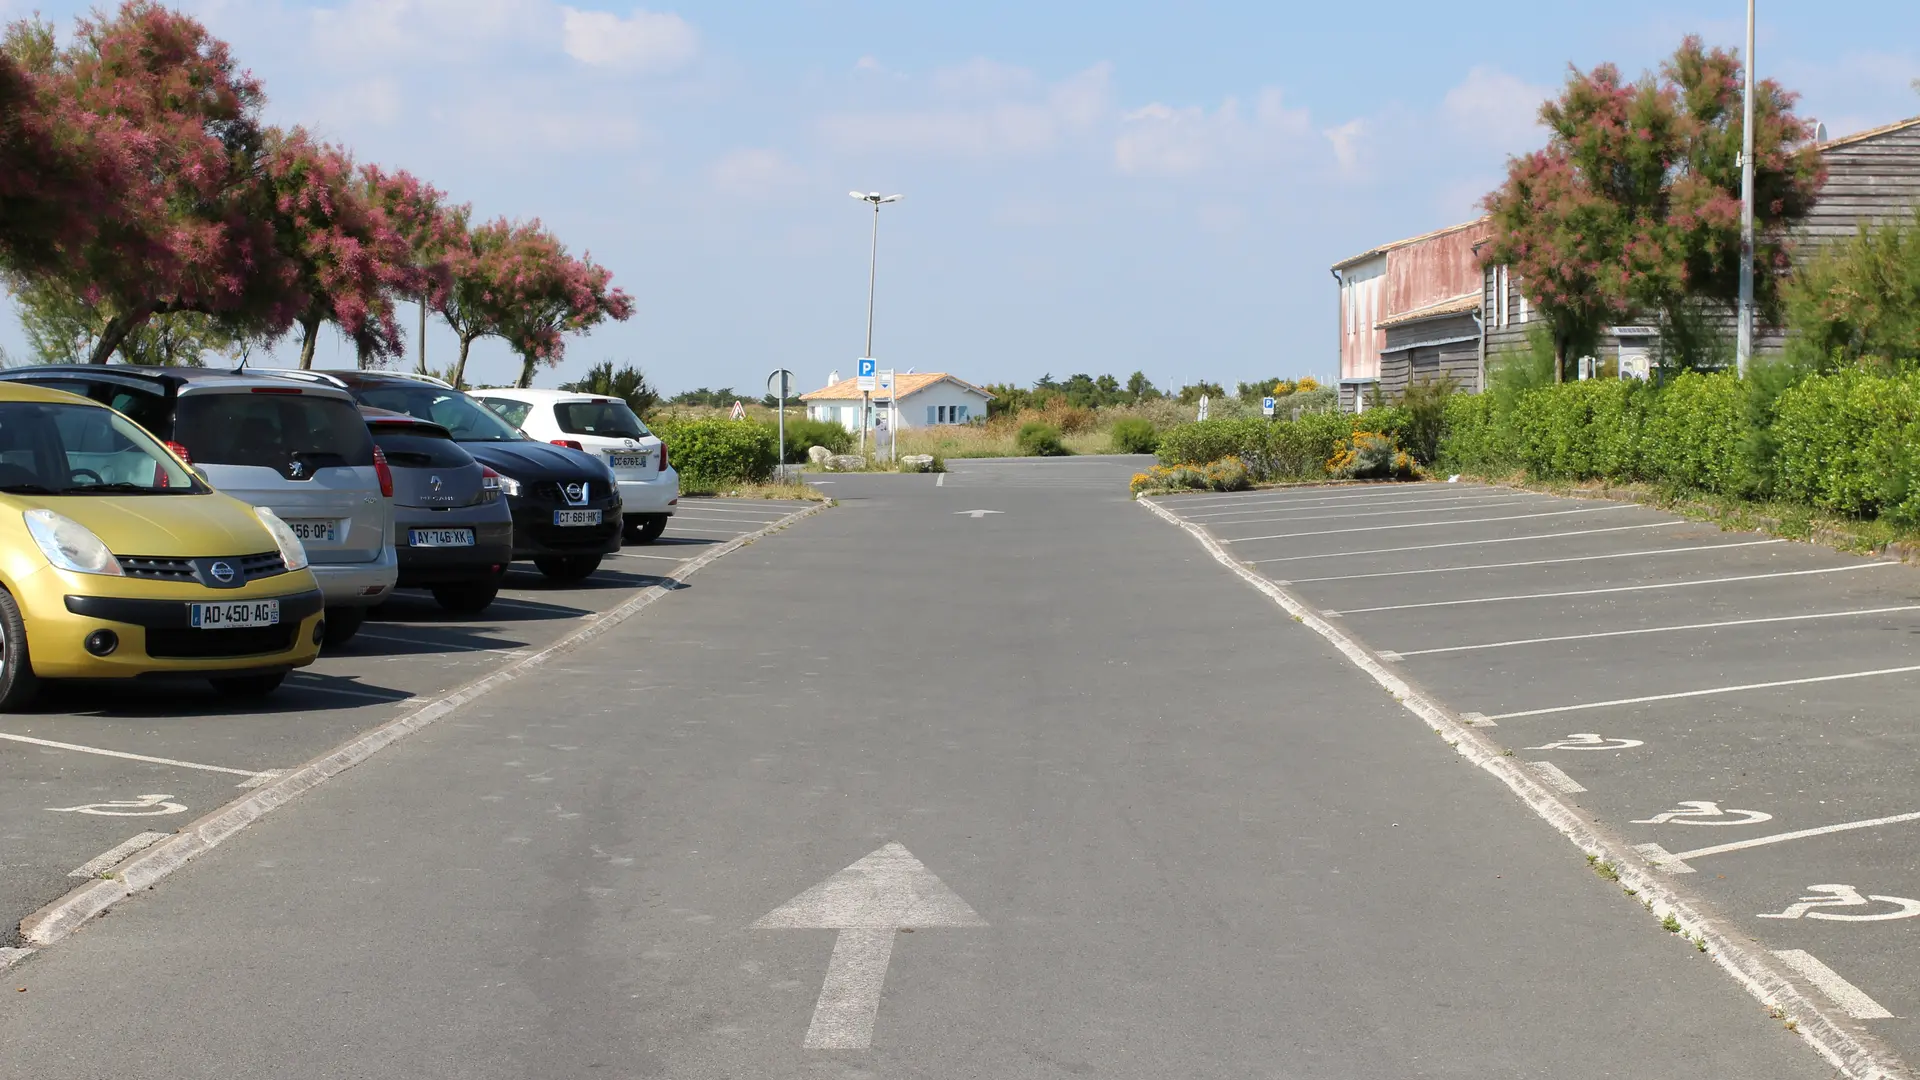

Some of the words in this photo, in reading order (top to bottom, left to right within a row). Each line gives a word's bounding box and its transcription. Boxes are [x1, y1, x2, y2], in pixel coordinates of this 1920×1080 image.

[863, 363, 872, 374] P
[560, 512, 597, 523] CT-661-HK
[418, 531, 467, 544] AY-746-XK
[204, 604, 269, 623] AD-450-AG
